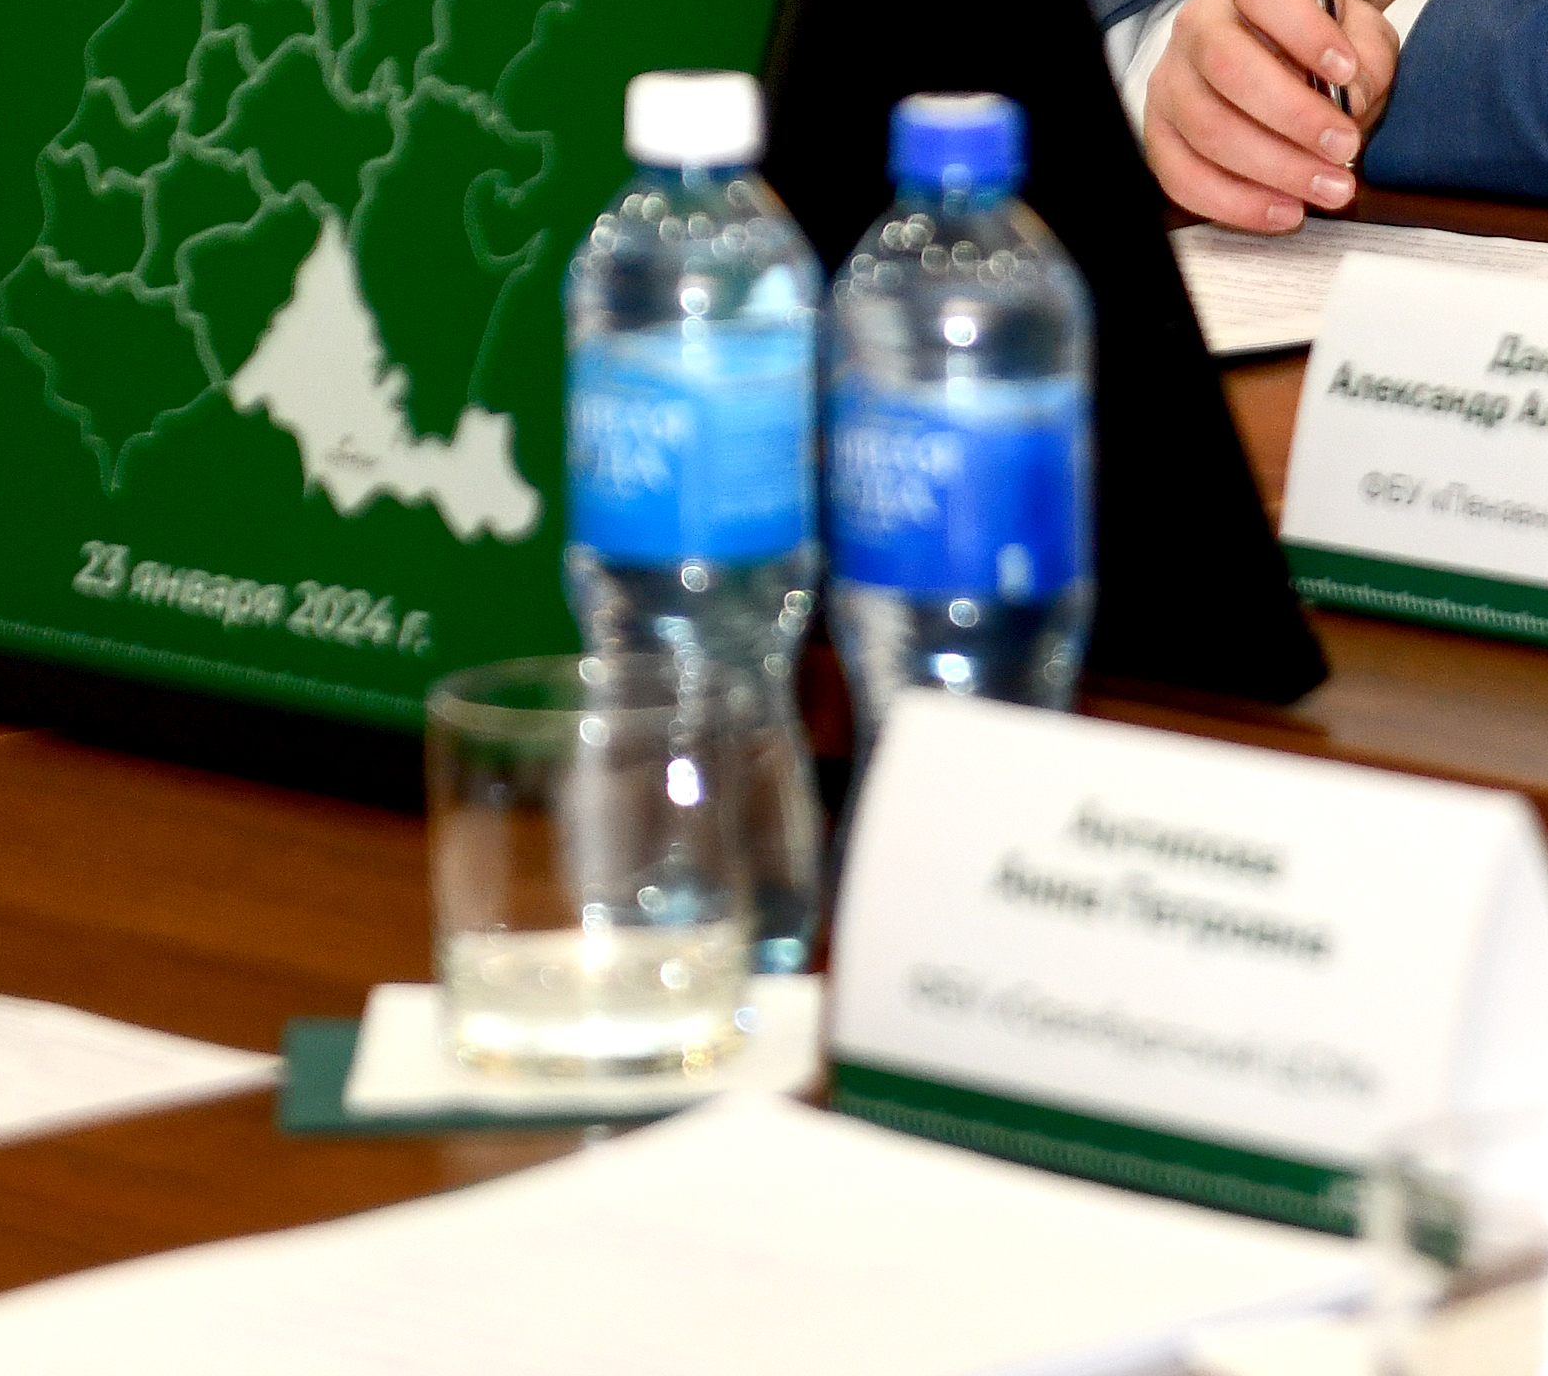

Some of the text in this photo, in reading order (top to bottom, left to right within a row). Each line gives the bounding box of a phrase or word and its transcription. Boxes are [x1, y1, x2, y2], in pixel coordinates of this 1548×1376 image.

[1329, 360, 1510, 430] Александр
[1359, 469, 1421, 507] ФБУ
[72, 540, 432, 657] 23 января 2024 г.
